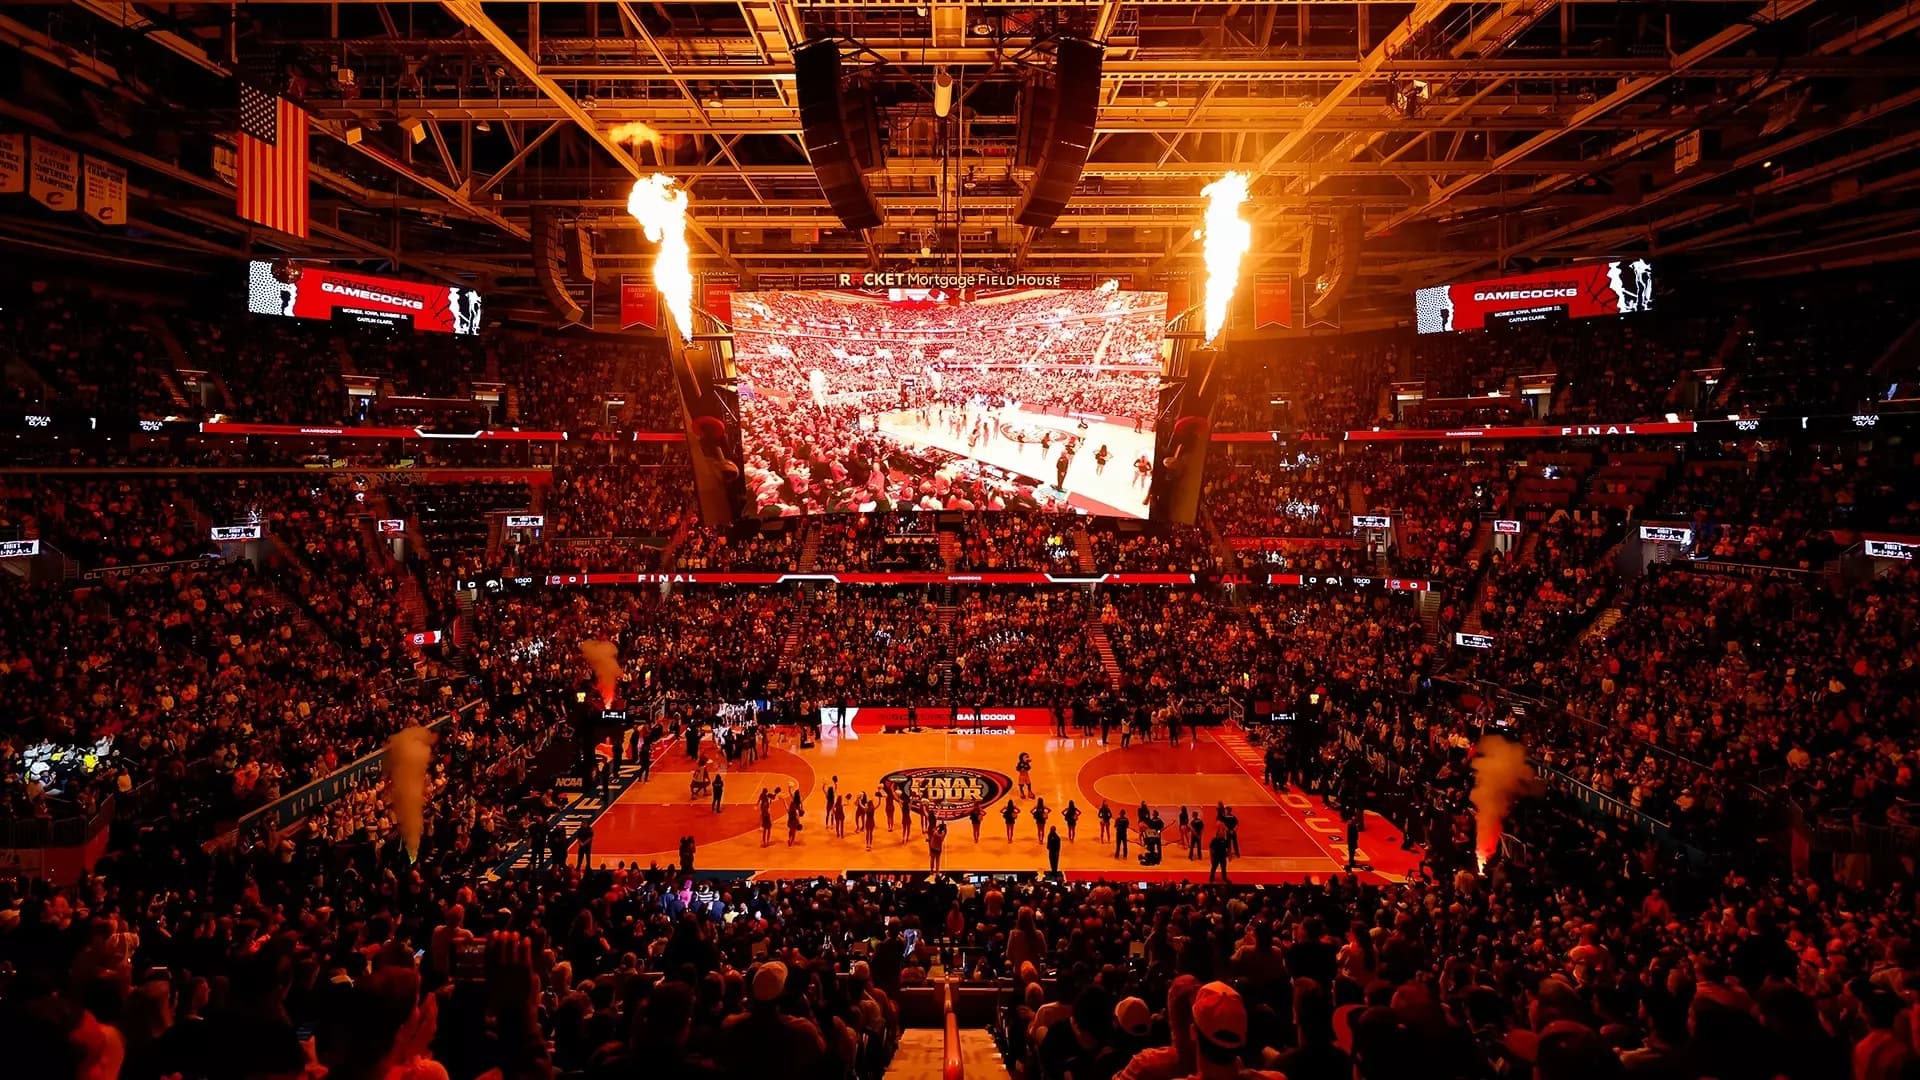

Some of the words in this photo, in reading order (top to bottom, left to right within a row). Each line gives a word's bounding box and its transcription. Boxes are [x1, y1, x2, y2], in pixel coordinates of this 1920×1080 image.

[34, 163, 75, 184] CONFERENCE
[907, 273, 975, 289] Mortgage
[321, 282, 424, 311] GAMECOCKS
[1474, 287, 1578, 301] GAMECOCKS
[591, 431, 620, 441] ALL
[1300, 431, 1330, 441] ALL
[1561, 425, 1636, 436] FINAL
[637, 574, 697, 583] FINAL
[1220, 573, 1253, 584] ALL
[555, 777, 583, 787] NCAA
[911, 777, 983, 788] FINAL
[910, 787, 984, 800] FOUR
